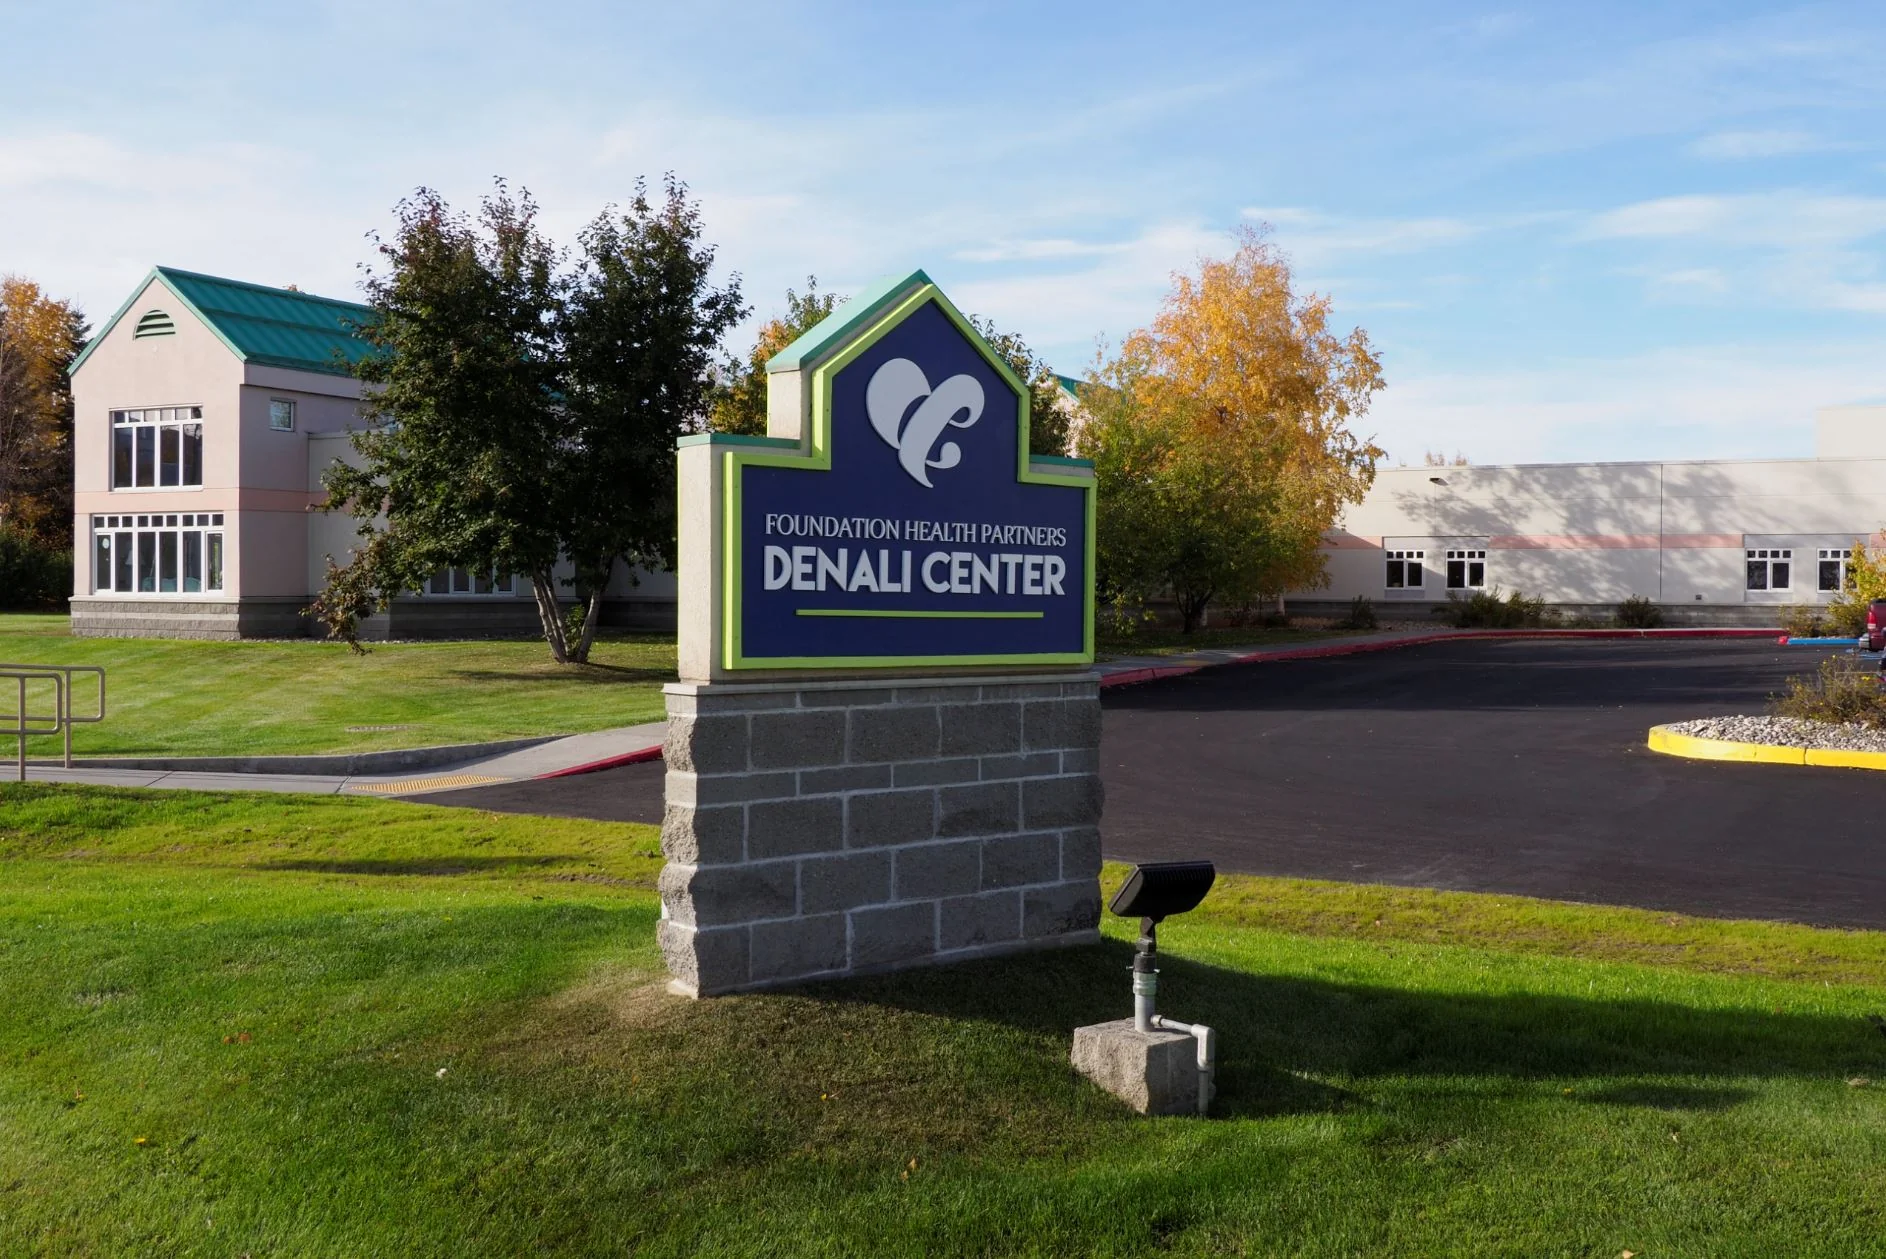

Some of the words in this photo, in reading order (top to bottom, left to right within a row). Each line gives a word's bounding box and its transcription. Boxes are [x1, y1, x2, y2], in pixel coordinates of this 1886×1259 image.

[765, 513, 900, 540] FOUNDATION
[904, 520, 976, 543] HEALTH
[981, 524, 1067, 547] PARTNERS
[763, 545, 912, 593] DENALI
[921, 551, 1066, 595] CENTER
